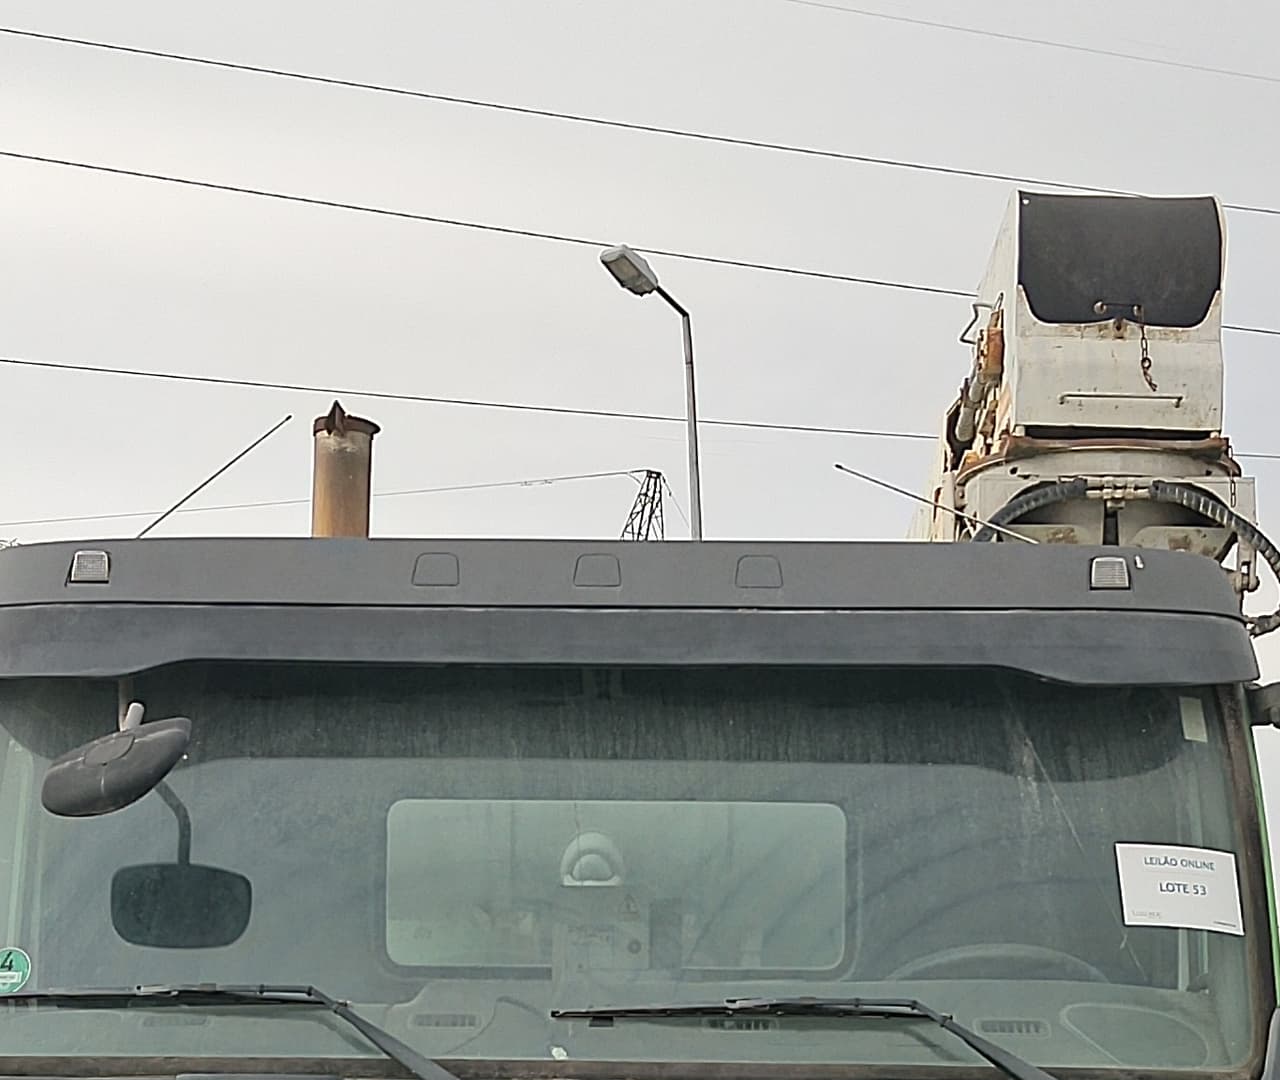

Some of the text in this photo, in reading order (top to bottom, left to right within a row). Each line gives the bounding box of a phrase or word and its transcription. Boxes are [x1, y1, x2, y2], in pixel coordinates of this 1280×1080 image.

[1143, 855, 1215, 871] LEILÃO ONLINE
[1159, 882, 1207, 896] LOTE 53
[0, 951, 14, 972] 4
